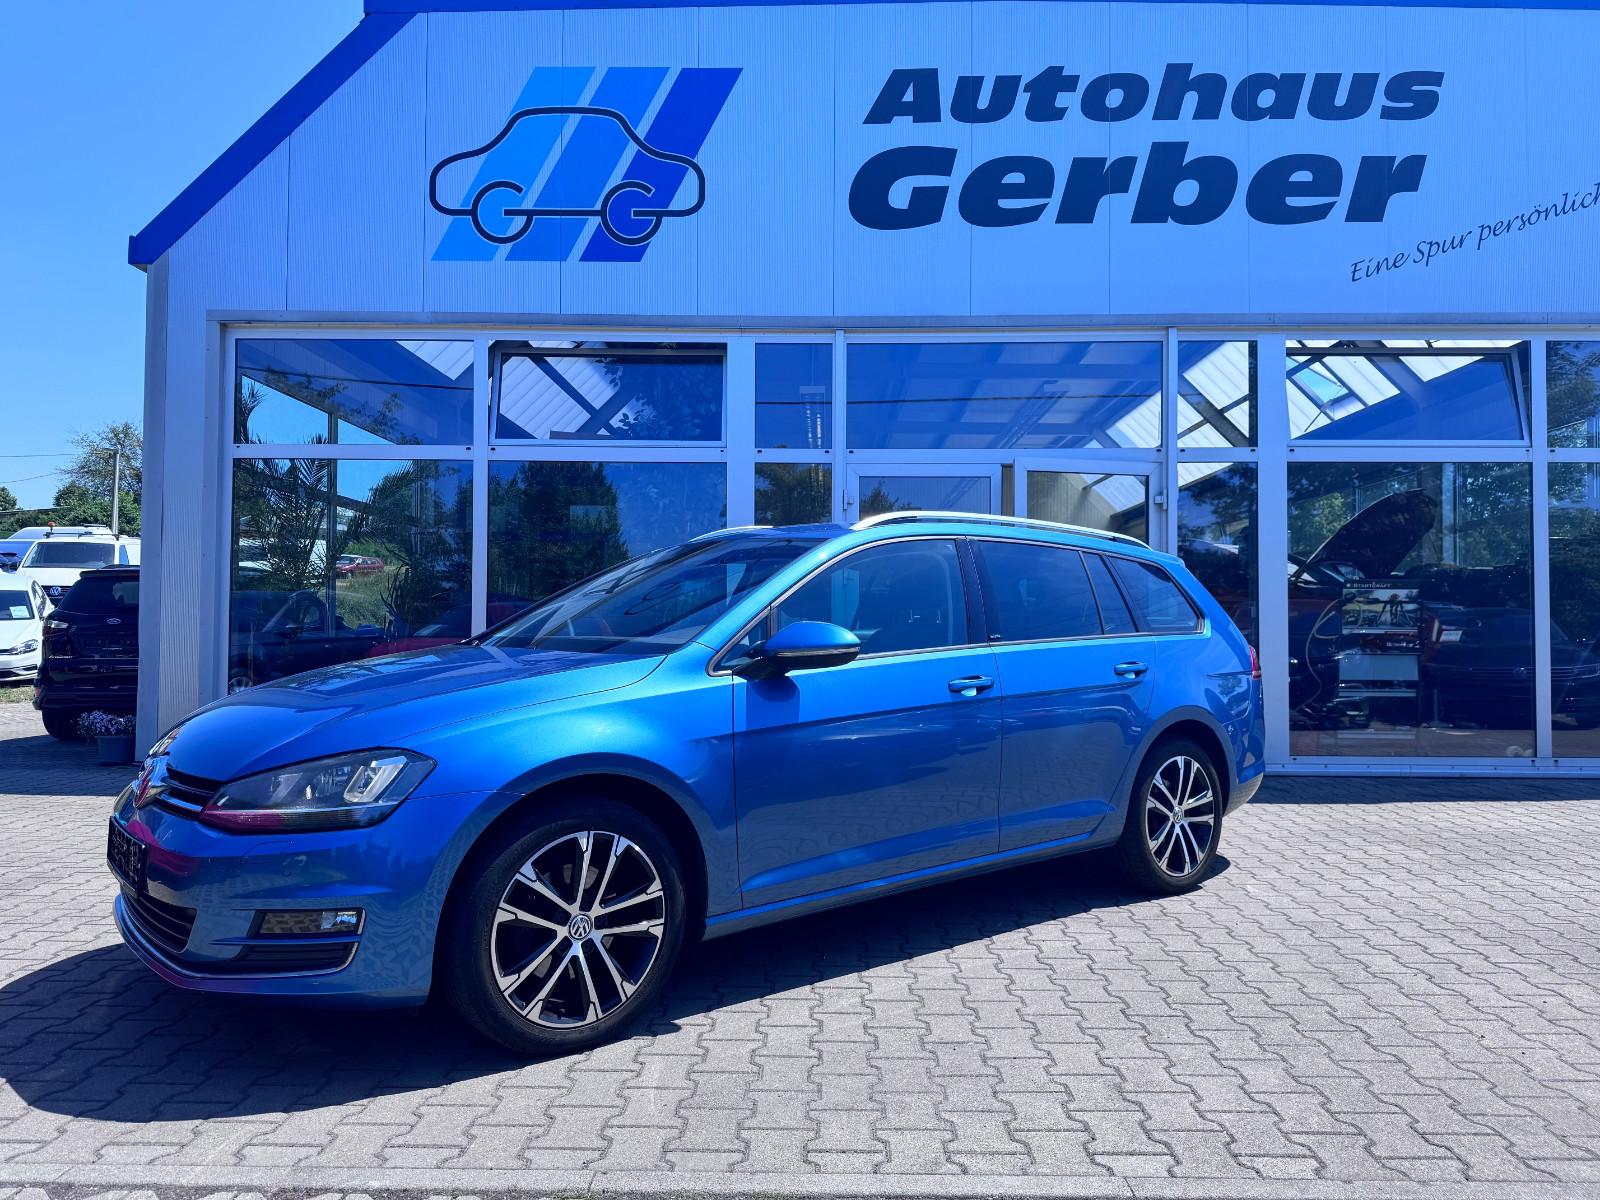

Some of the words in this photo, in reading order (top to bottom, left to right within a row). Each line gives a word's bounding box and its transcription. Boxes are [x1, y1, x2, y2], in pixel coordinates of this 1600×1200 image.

[862, 62, 1445, 125] Autohaus
[848, 141, 1428, 231] Gerber
[1351, 252, 1411, 283] Eine
[1412, 230, 1473, 267] Spur
